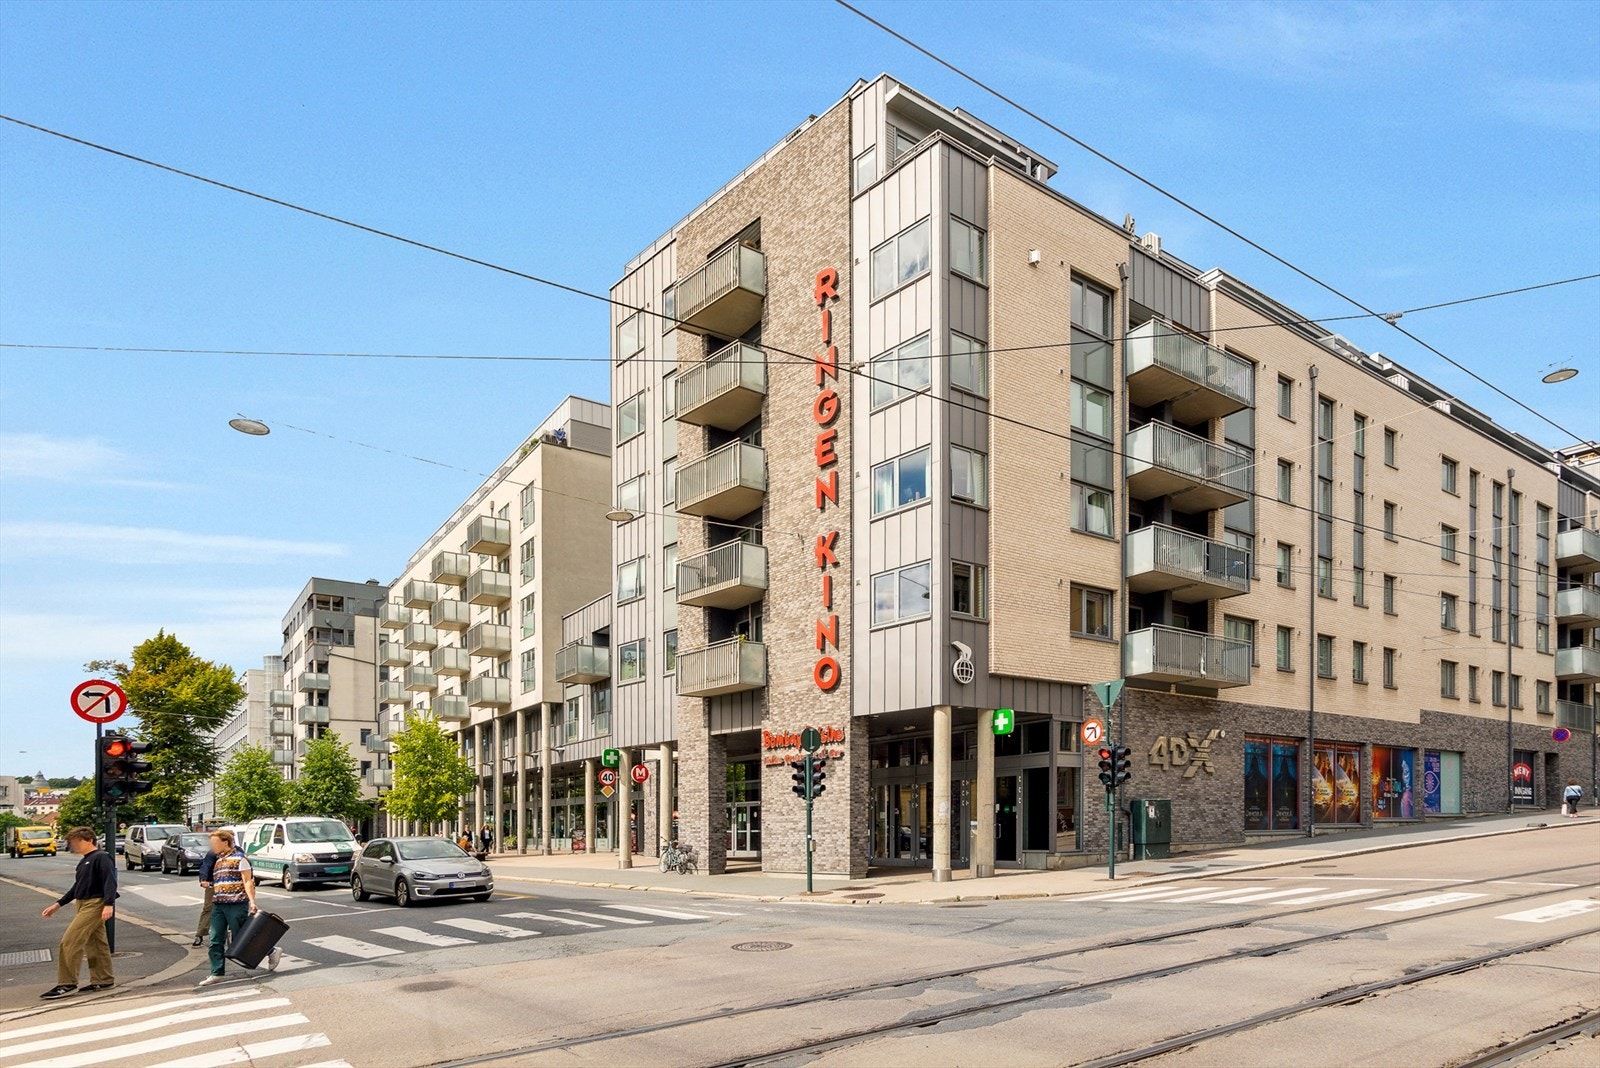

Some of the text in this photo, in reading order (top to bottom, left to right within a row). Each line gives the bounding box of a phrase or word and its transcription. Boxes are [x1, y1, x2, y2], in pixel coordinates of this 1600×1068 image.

[814, 267, 840, 691] RINGEN KINO
[763, 730, 801, 750] Bombay
[1148, 729, 1220, 778] 4DX
[602, 774, 614, 782] 40
[1514, 766, 1530, 776] MENY
